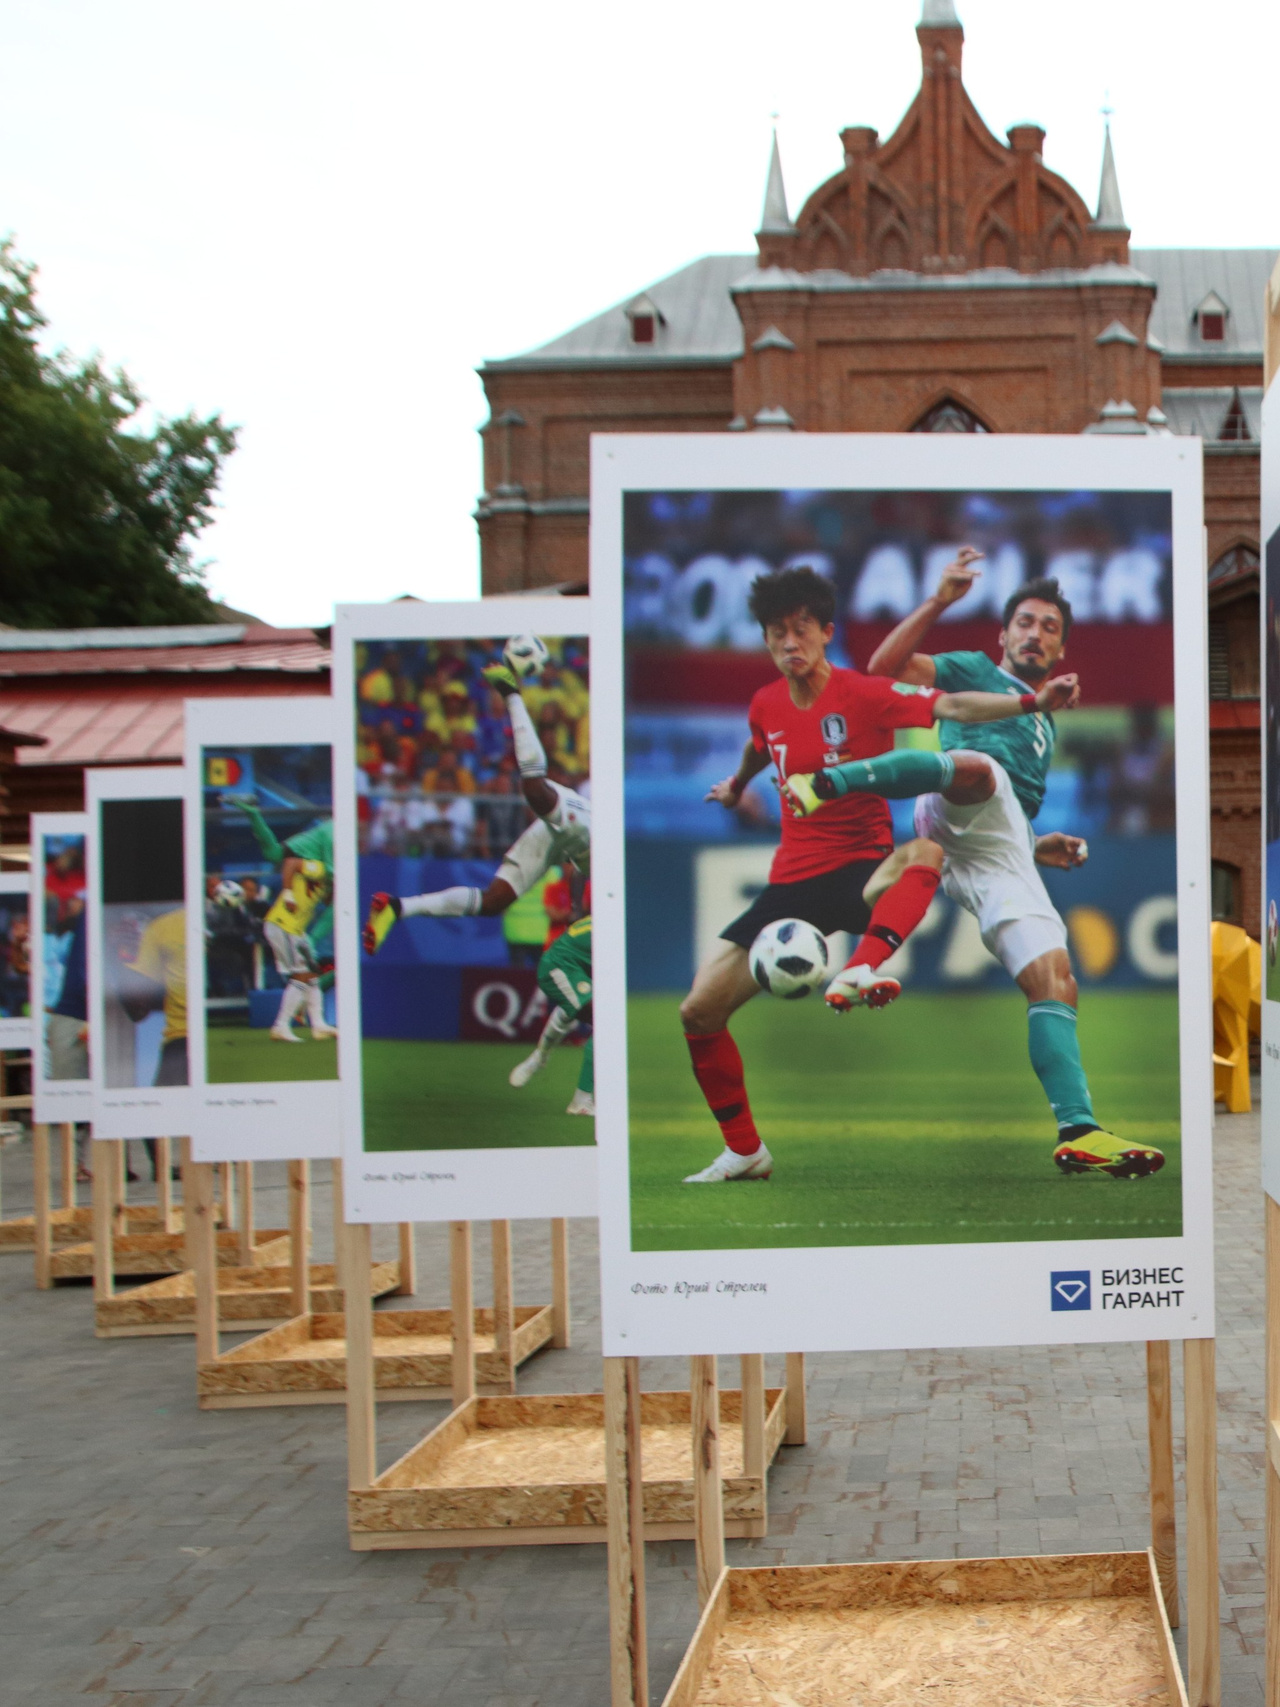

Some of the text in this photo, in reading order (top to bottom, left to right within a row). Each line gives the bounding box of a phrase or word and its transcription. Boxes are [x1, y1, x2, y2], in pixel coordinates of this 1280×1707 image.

[1101, 1266, 1184, 1287] БИЗНЕС
[630, 1282, 668, 1295] Фото
[673, 1280, 711, 1298] Юрий
[1102, 1289, 1185, 1310] ГАРАНТ
